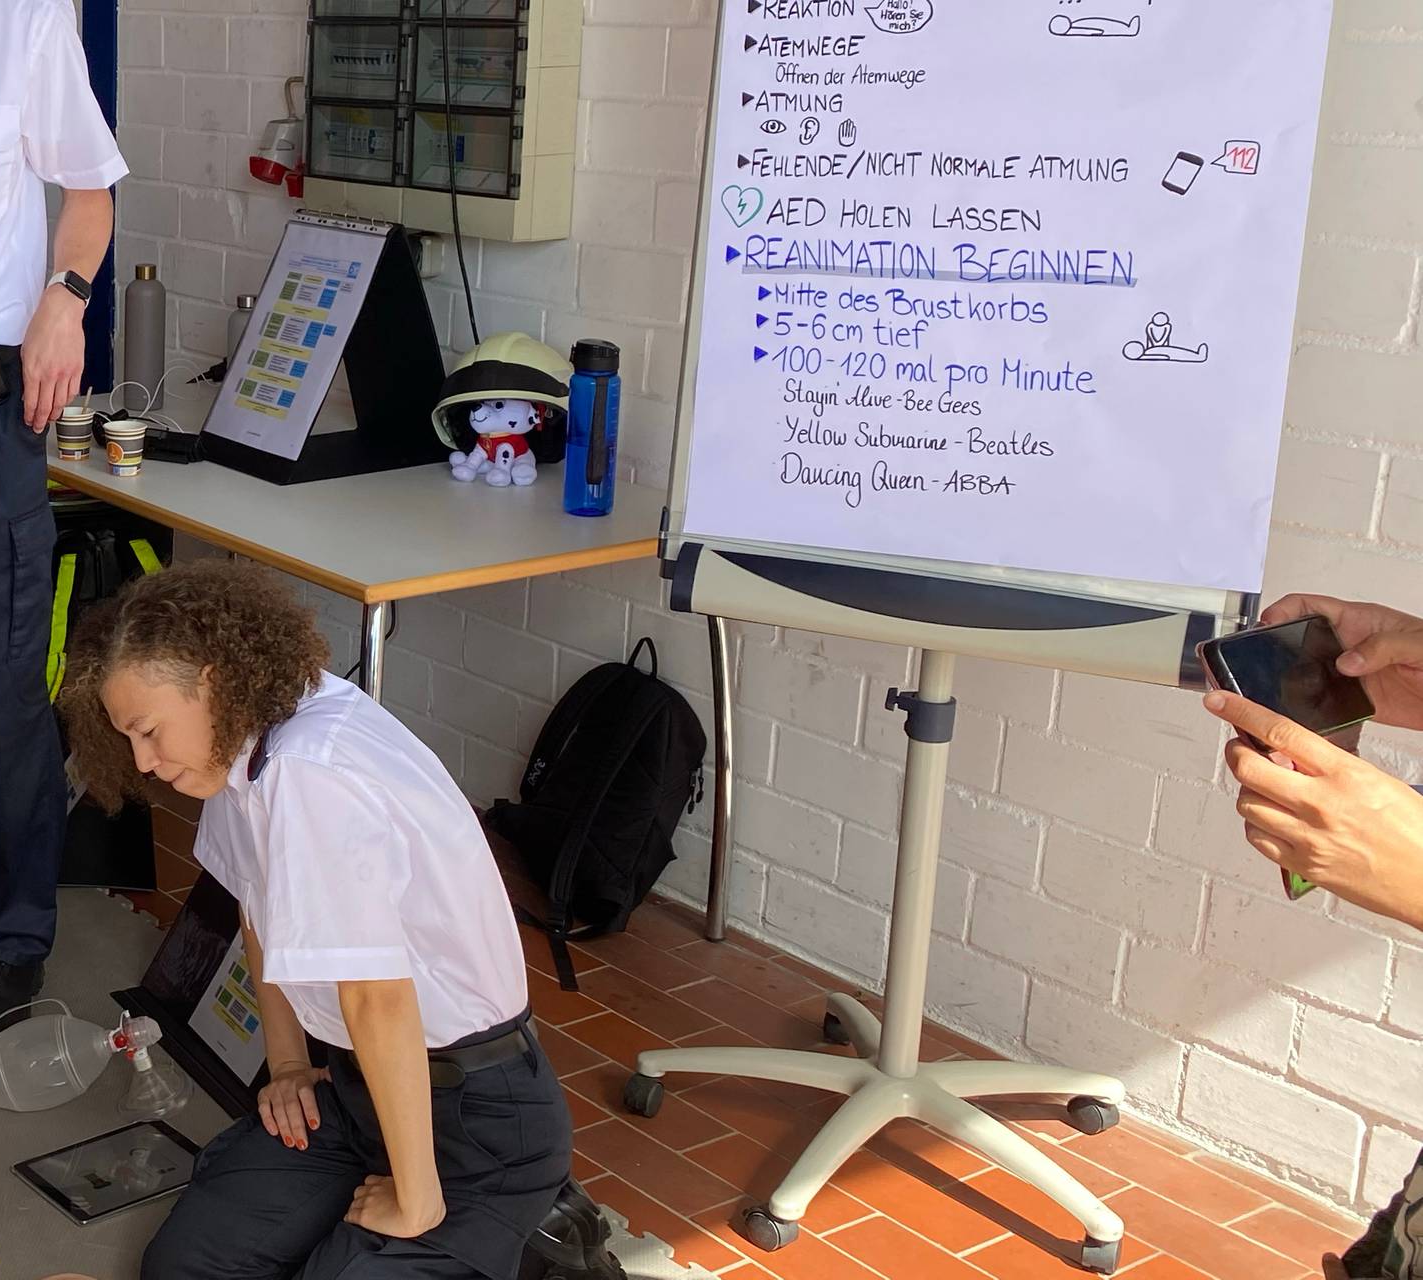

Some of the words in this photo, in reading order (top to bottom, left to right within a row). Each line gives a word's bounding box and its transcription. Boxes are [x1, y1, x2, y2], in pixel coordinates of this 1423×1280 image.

[764, 0, 855, 19] REAKTION
[758, 33, 866, 58] ATEMWEGE
[776, 62, 819, 86] Öffnen
[824, 68, 846, 86] der
[850, 64, 927, 90] Atemwege
[755, 90, 843, 113] ATMUNG
[930, 151, 1021, 179] NORMALE
[1028, 154, 1129, 183] ATMUNG
[1226, 146, 1258, 171] 112
[766, 197, 827, 227] AED
[840, 199, 912, 229] HOLEN
[932, 203, 1042, 232] LASSEN
[744, 234, 936, 280] REANIMATION
[952, 243, 1135, 285] BEGINNEN
[774, 282, 828, 308] Mitte
[838, 286, 880, 312] des
[884, 288, 1048, 324] Brustkorbs
[832, 323, 864, 344] cm
[873, 317, 929, 349] tief
[771, 345, 886, 380] 100-120
[896, 353, 938, 383] mal
[944, 362, 989, 394] pro
[1001, 358, 1097, 395] Minute
[938, 391, 982, 416] Gees
[783, 415, 847, 446] Yellow
[854, 421, 948, 450] Submarine
[966, 426, 1055, 457] Beatles
[780, 452, 862, 508] Dancing
[871, 460, 927, 493] Queen
[942, 469, 1016, 495] ABBA
